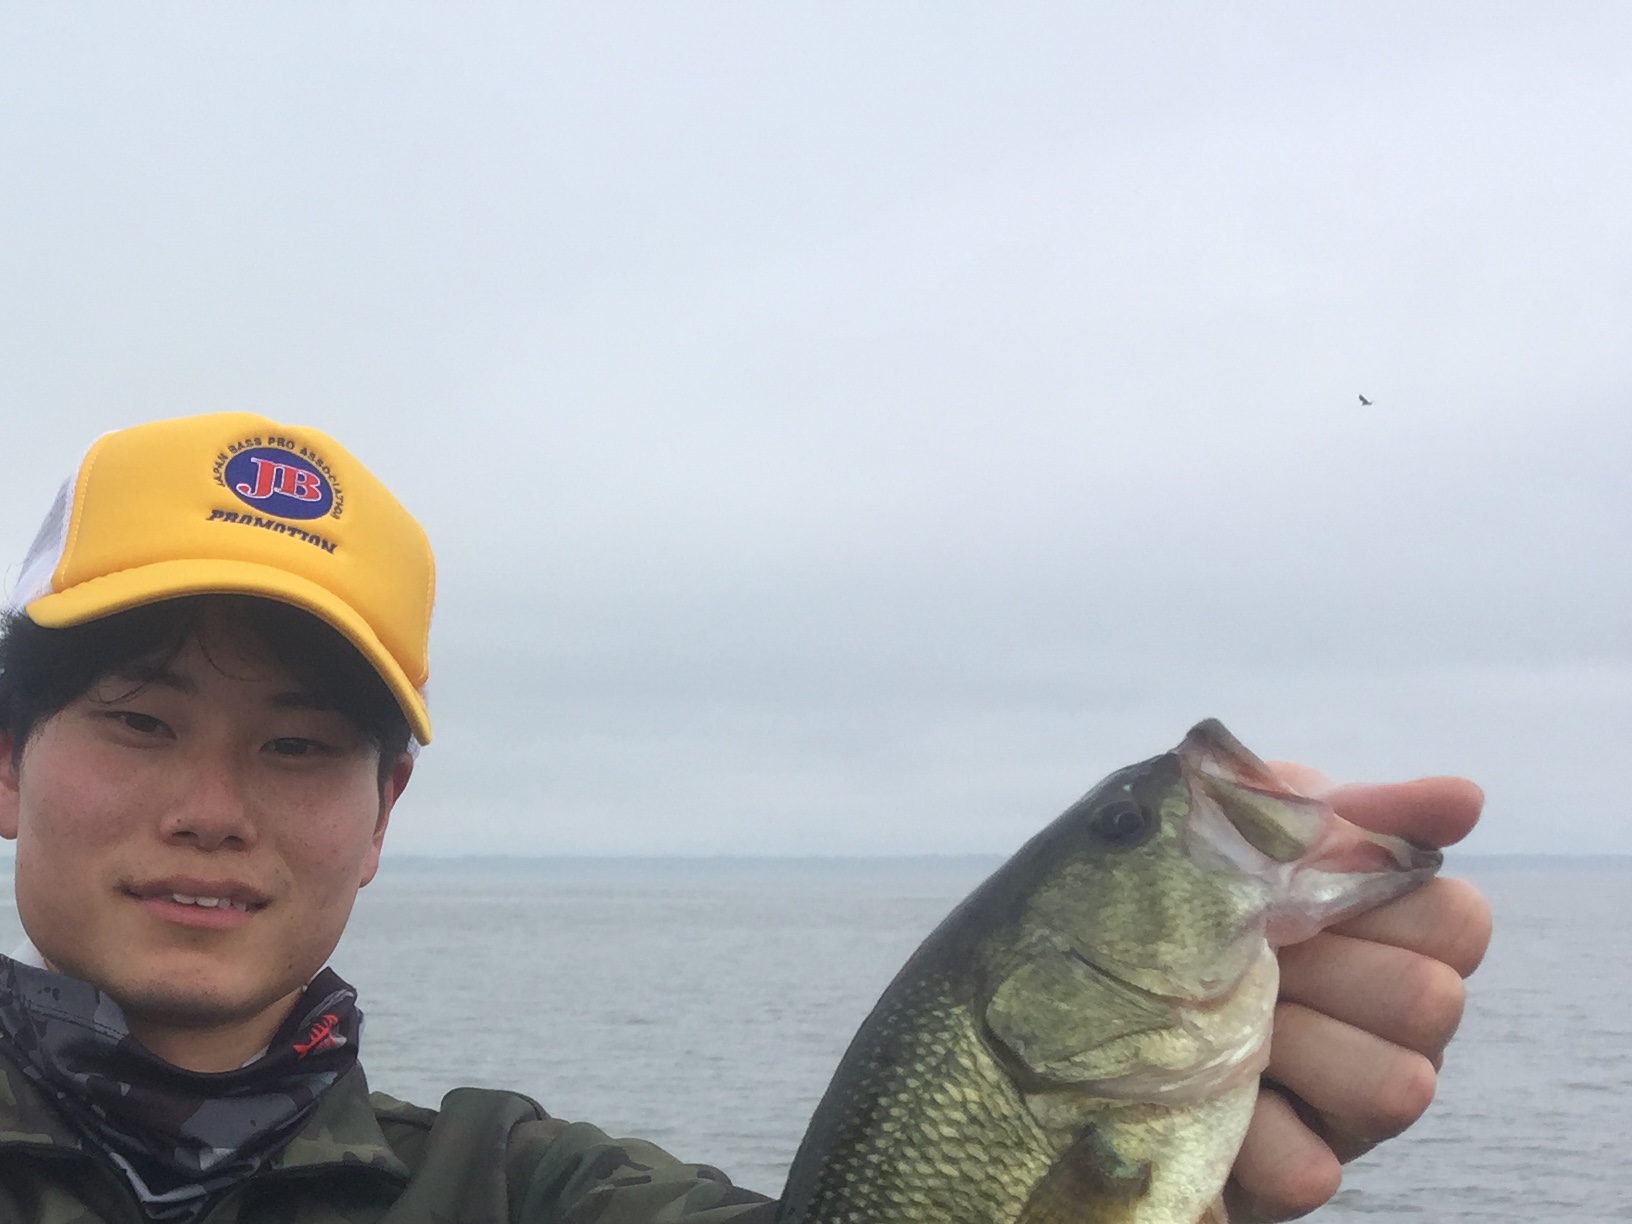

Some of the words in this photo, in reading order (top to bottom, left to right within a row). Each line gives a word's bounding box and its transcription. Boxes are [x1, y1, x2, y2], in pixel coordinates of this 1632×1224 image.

[213, 453, 228, 487] JAPAN
[228, 437, 262, 455] BASS
[268, 437, 295, 450] PRO
[300, 447, 344, 520] ASSOCIATION
[236, 457, 322, 502] JB
[206, 509, 338, 555] PROMOTION
